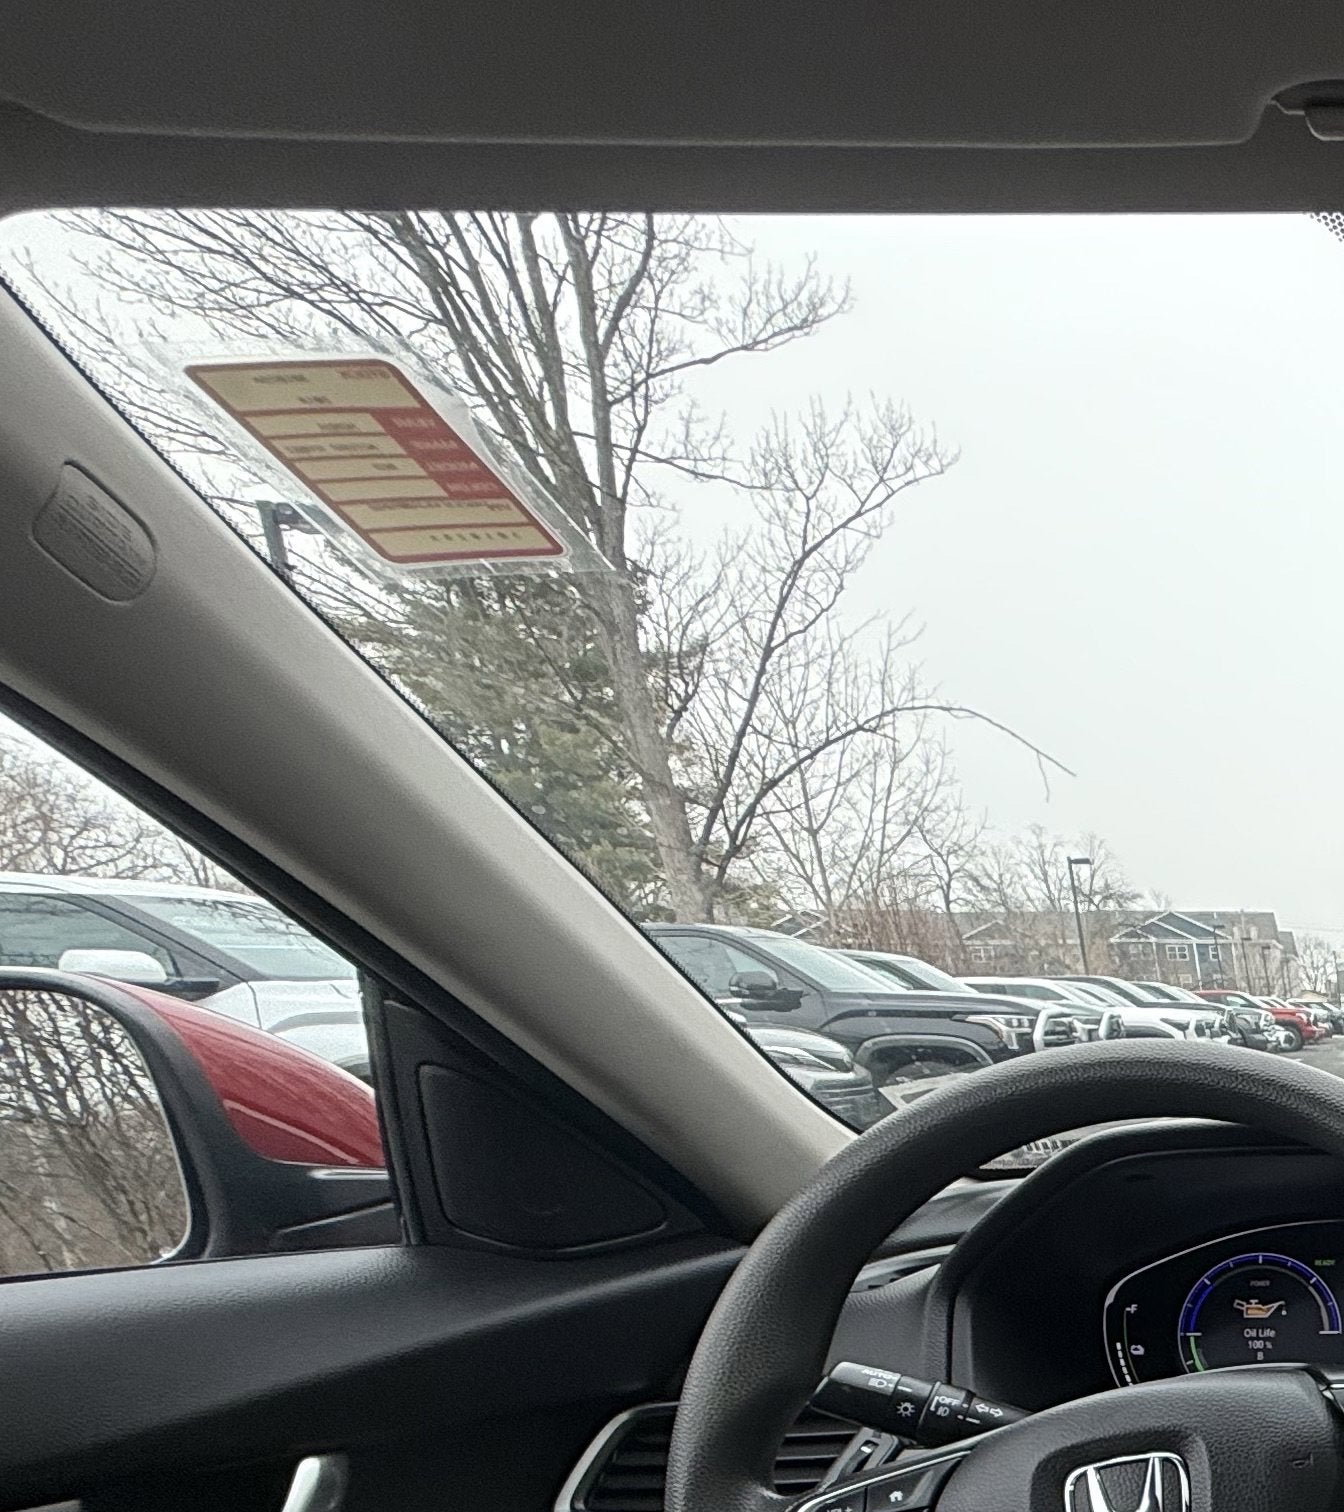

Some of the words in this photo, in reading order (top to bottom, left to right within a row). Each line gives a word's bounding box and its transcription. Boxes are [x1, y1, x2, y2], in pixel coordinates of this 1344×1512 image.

[1243, 1329, 1257, 1338] Oil
[1258, 1329, 1276, 1338] Life
[1248, 1341, 1264, 1350] 100
[1256, 1352, 1264, 1361] B
[938, 1395, 963, 1406] OFF
